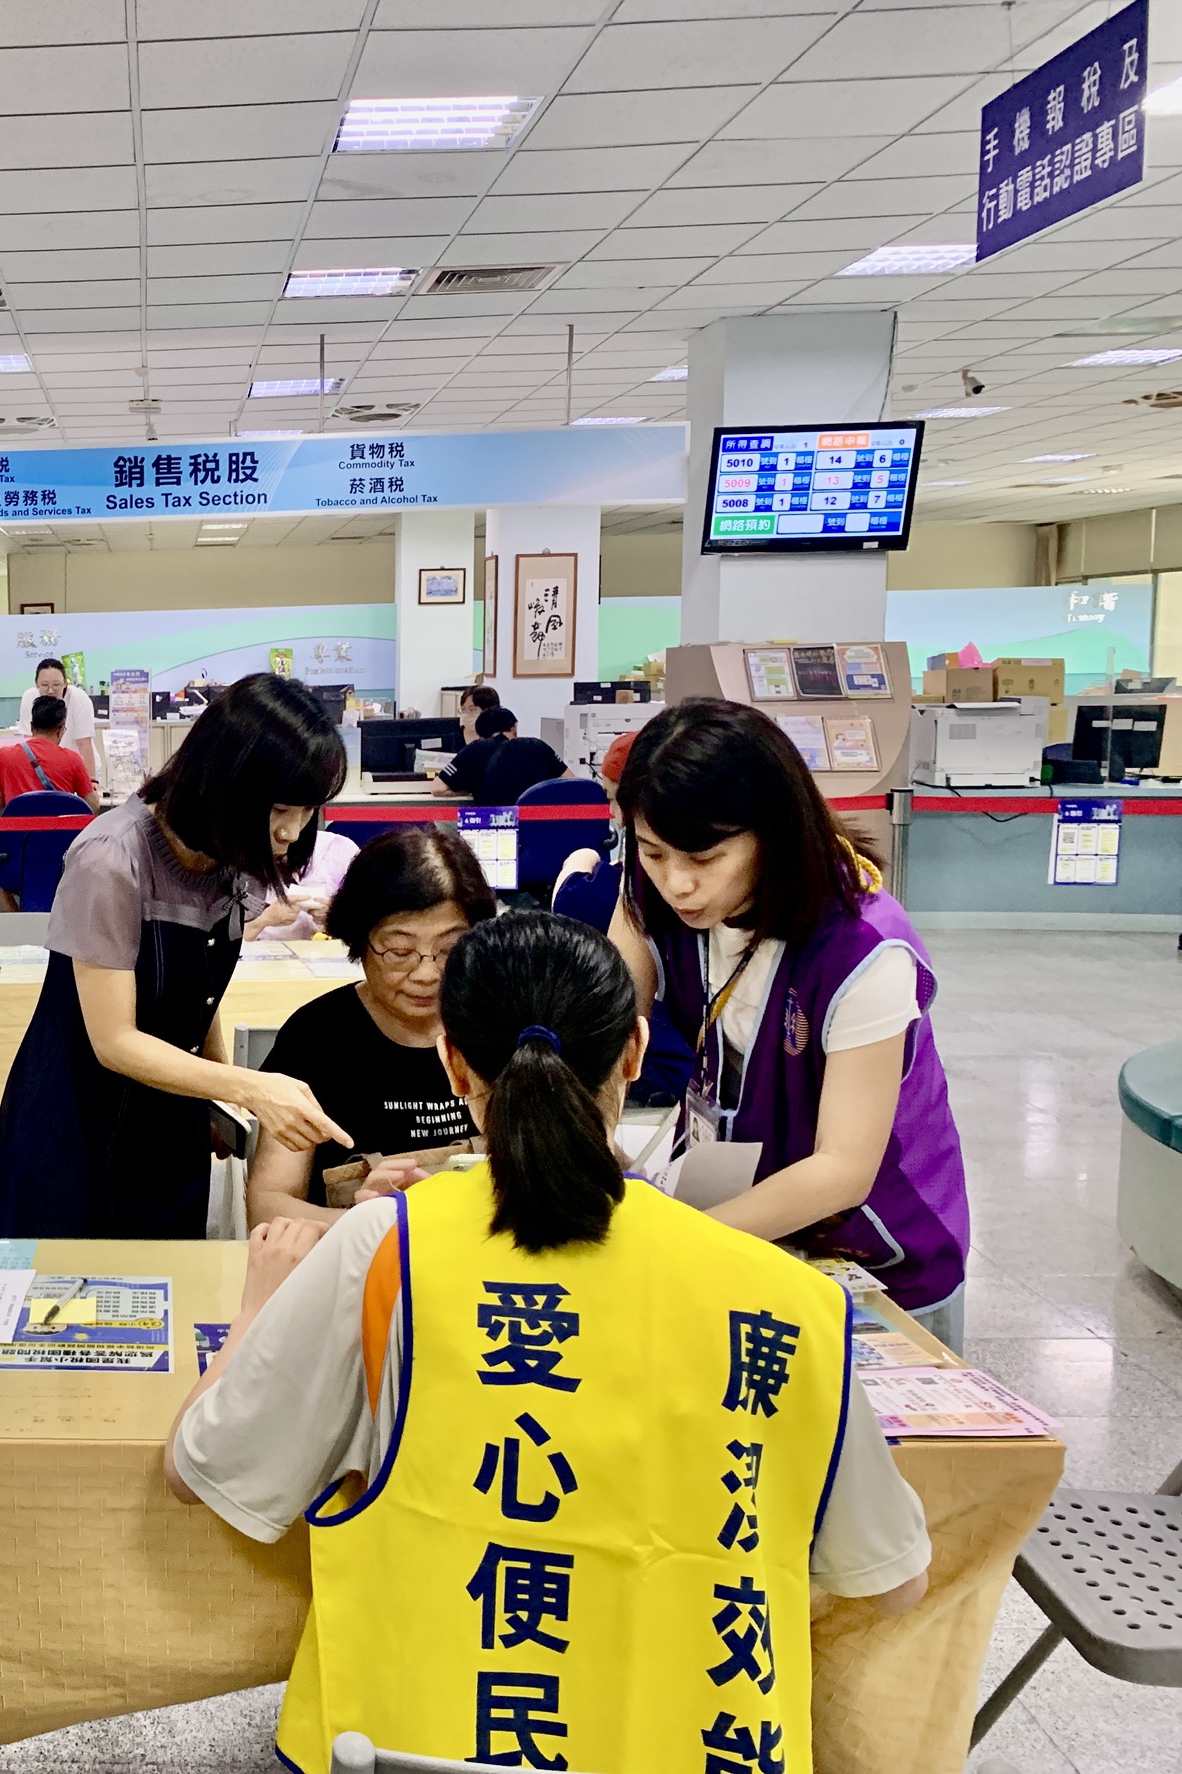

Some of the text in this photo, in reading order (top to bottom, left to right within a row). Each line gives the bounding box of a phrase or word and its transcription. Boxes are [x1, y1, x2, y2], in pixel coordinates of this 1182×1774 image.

[983, 37, 1139, 173] 手機報稅及
[981, 103, 1139, 232] 行動電話認證專區
[349, 441, 405, 461] 貨物稅
[338, 459, 415, 471] Commodity Tax
[726, 458, 754, 469] 5010
[783, 457, 789, 466] 1
[829, 455, 842, 465] 14
[879, 454, 886, 464] 6
[113, 451, 260, 489] 銷售稅股
[348, 476, 405, 495] 菸酒稅
[724, 478, 751, 488] 5009
[781, 478, 787, 487] 1
[826, 476, 840, 485] 13
[876, 475, 884, 484] 5
[105, 489, 268, 510] Sales Tax Section
[316, 494, 438, 507] Tobacco and Alcohol Tax
[721, 498, 749, 509] 5008
[779, 497, 785, 507] 1
[823, 496, 838, 506] 12
[874, 495, 881, 504] 7
[11, 507, 24, 517] and
[26, 506, 73, 517] Services
[75, 505, 92, 515] Tax
[719, 519, 771, 533] 網路預約
[16, 628, 61, 649] 服務
[24, 650, 55, 659] Service
[383, 1101, 424, 1110] SUNLIGHT
[425, 1099, 455, 1111] WRAPS
[415, 1111, 462, 1125] BEGINNING
[410, 1129, 429, 1138] NEW
[464, 1280, 582, 1772] 愛心便民
